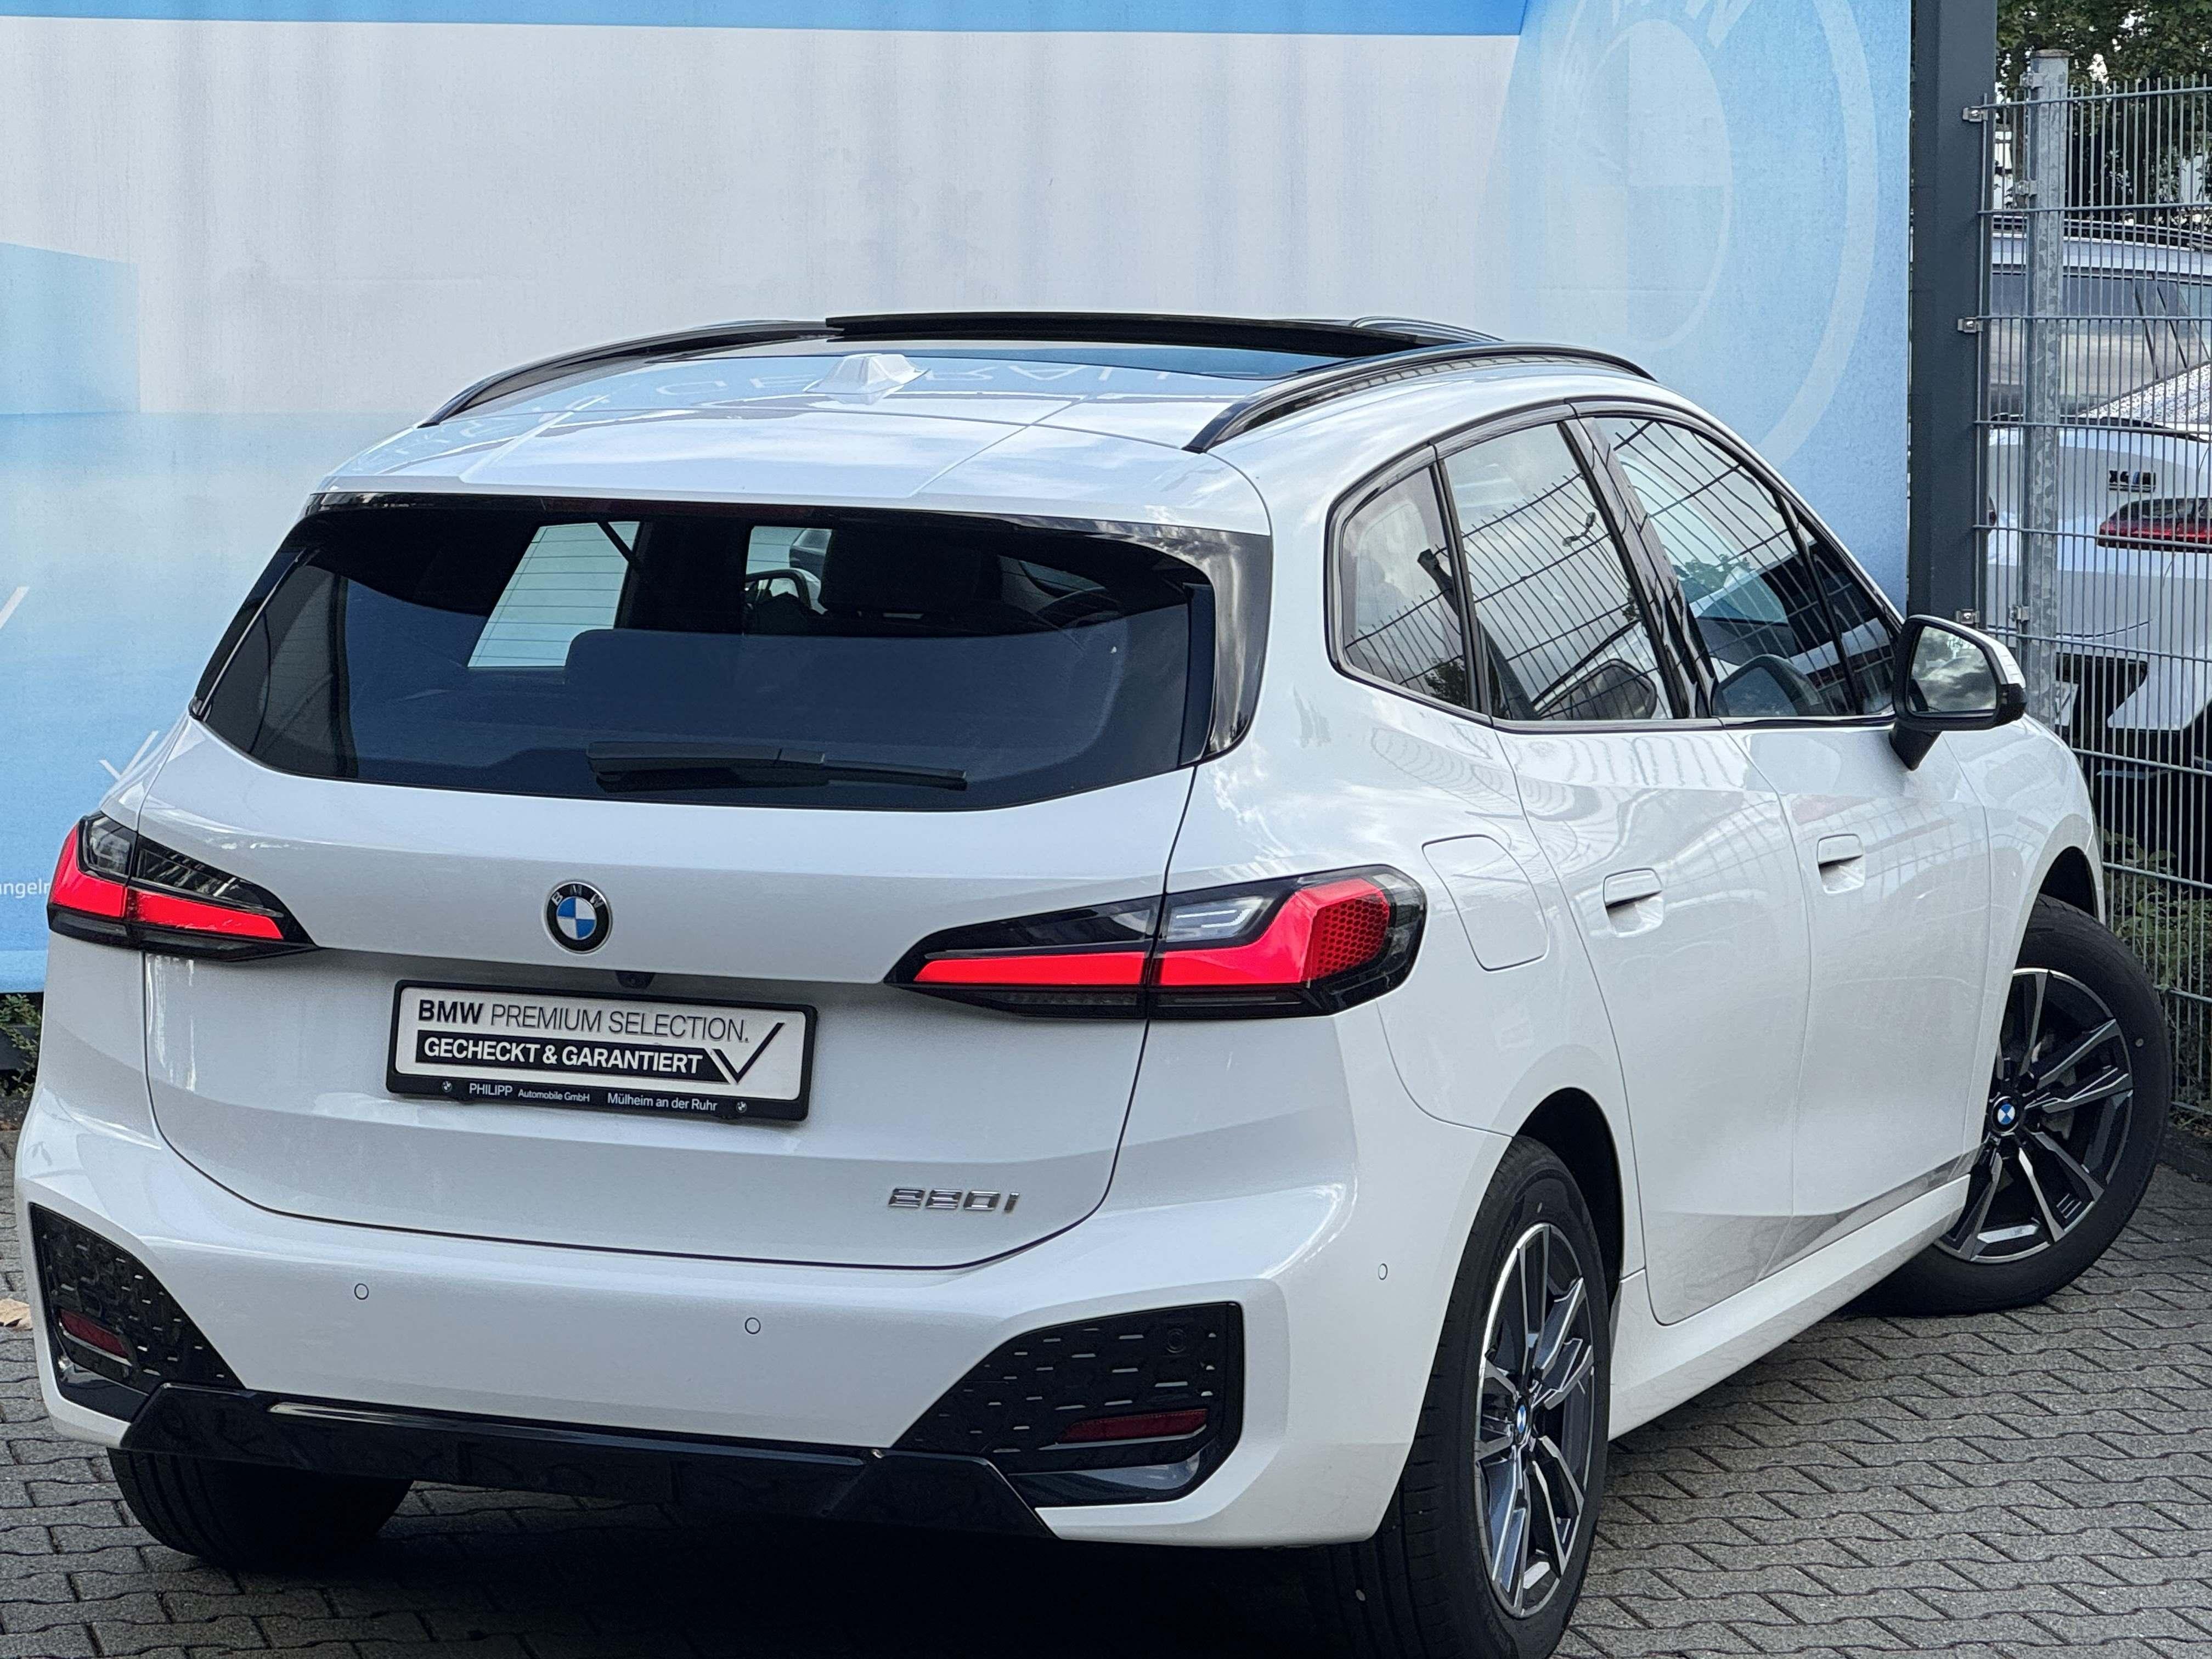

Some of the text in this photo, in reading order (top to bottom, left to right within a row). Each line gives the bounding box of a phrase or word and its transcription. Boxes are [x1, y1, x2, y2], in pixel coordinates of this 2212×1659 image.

[551, 884, 604, 909] BMW
[419, 999, 749, 1043] BMW PREMIUM SELECTION.
[424, 1037, 703, 1074] GECHECKT & GARANTIERT
[469, 1082, 718, 1111] PHILIPP Automobile GmbH Mülheim an der Ruhr
[888, 1187, 1020, 1213] 220i
